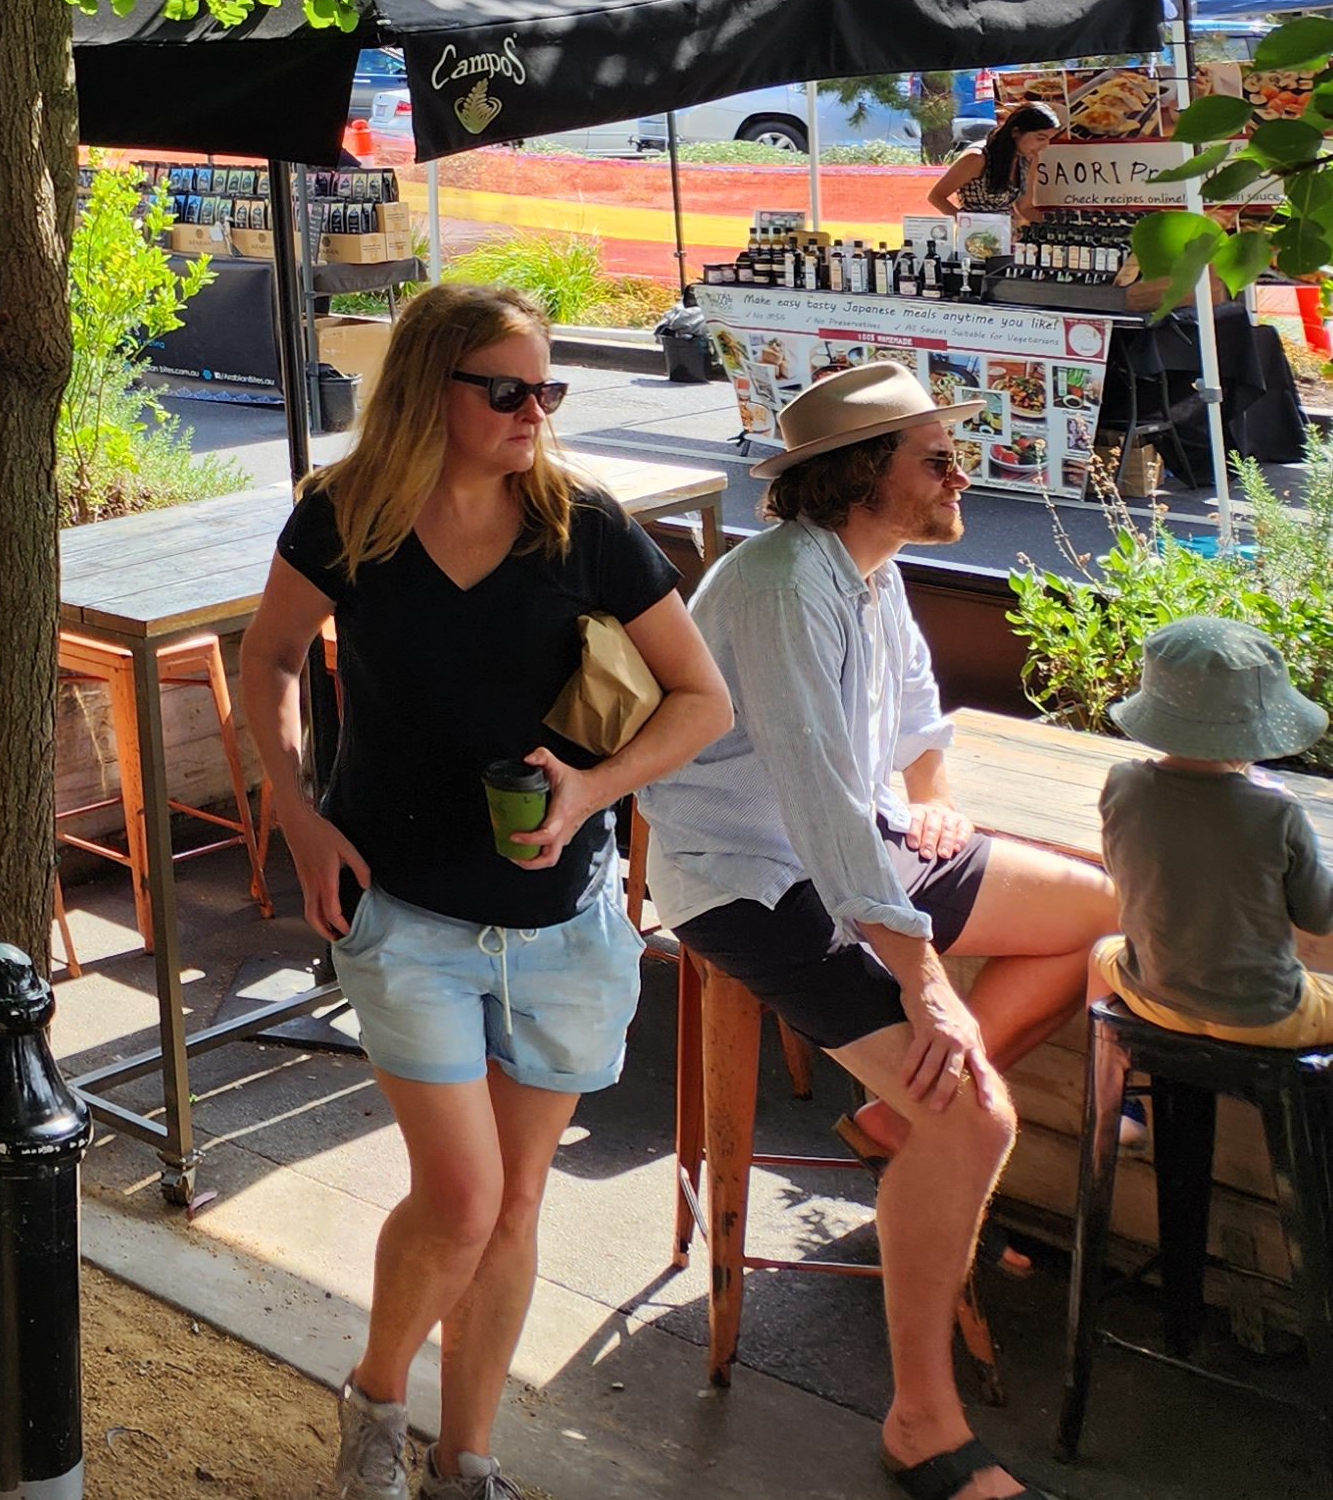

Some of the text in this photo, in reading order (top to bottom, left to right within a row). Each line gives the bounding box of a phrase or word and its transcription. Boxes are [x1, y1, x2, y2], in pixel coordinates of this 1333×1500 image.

[1036, 161, 1121, 185] SAORI
[1064, 192, 1186, 206] Check recipes online!
[743, 294, 772, 306] Make
[777, 297, 801, 309] easy
[806, 299, 837, 312] tasty
[842, 301, 896, 316] Japanese
[903, 308, 937, 320] meals
[942, 311, 995, 326] anytime
[1001, 318, 1024, 329] you
[1031, 317, 1059, 331] like!
[951, 328, 986, 341] Suitable
[989, 332, 1003, 341] for
[1007, 334, 1060, 347] Vegetarians
